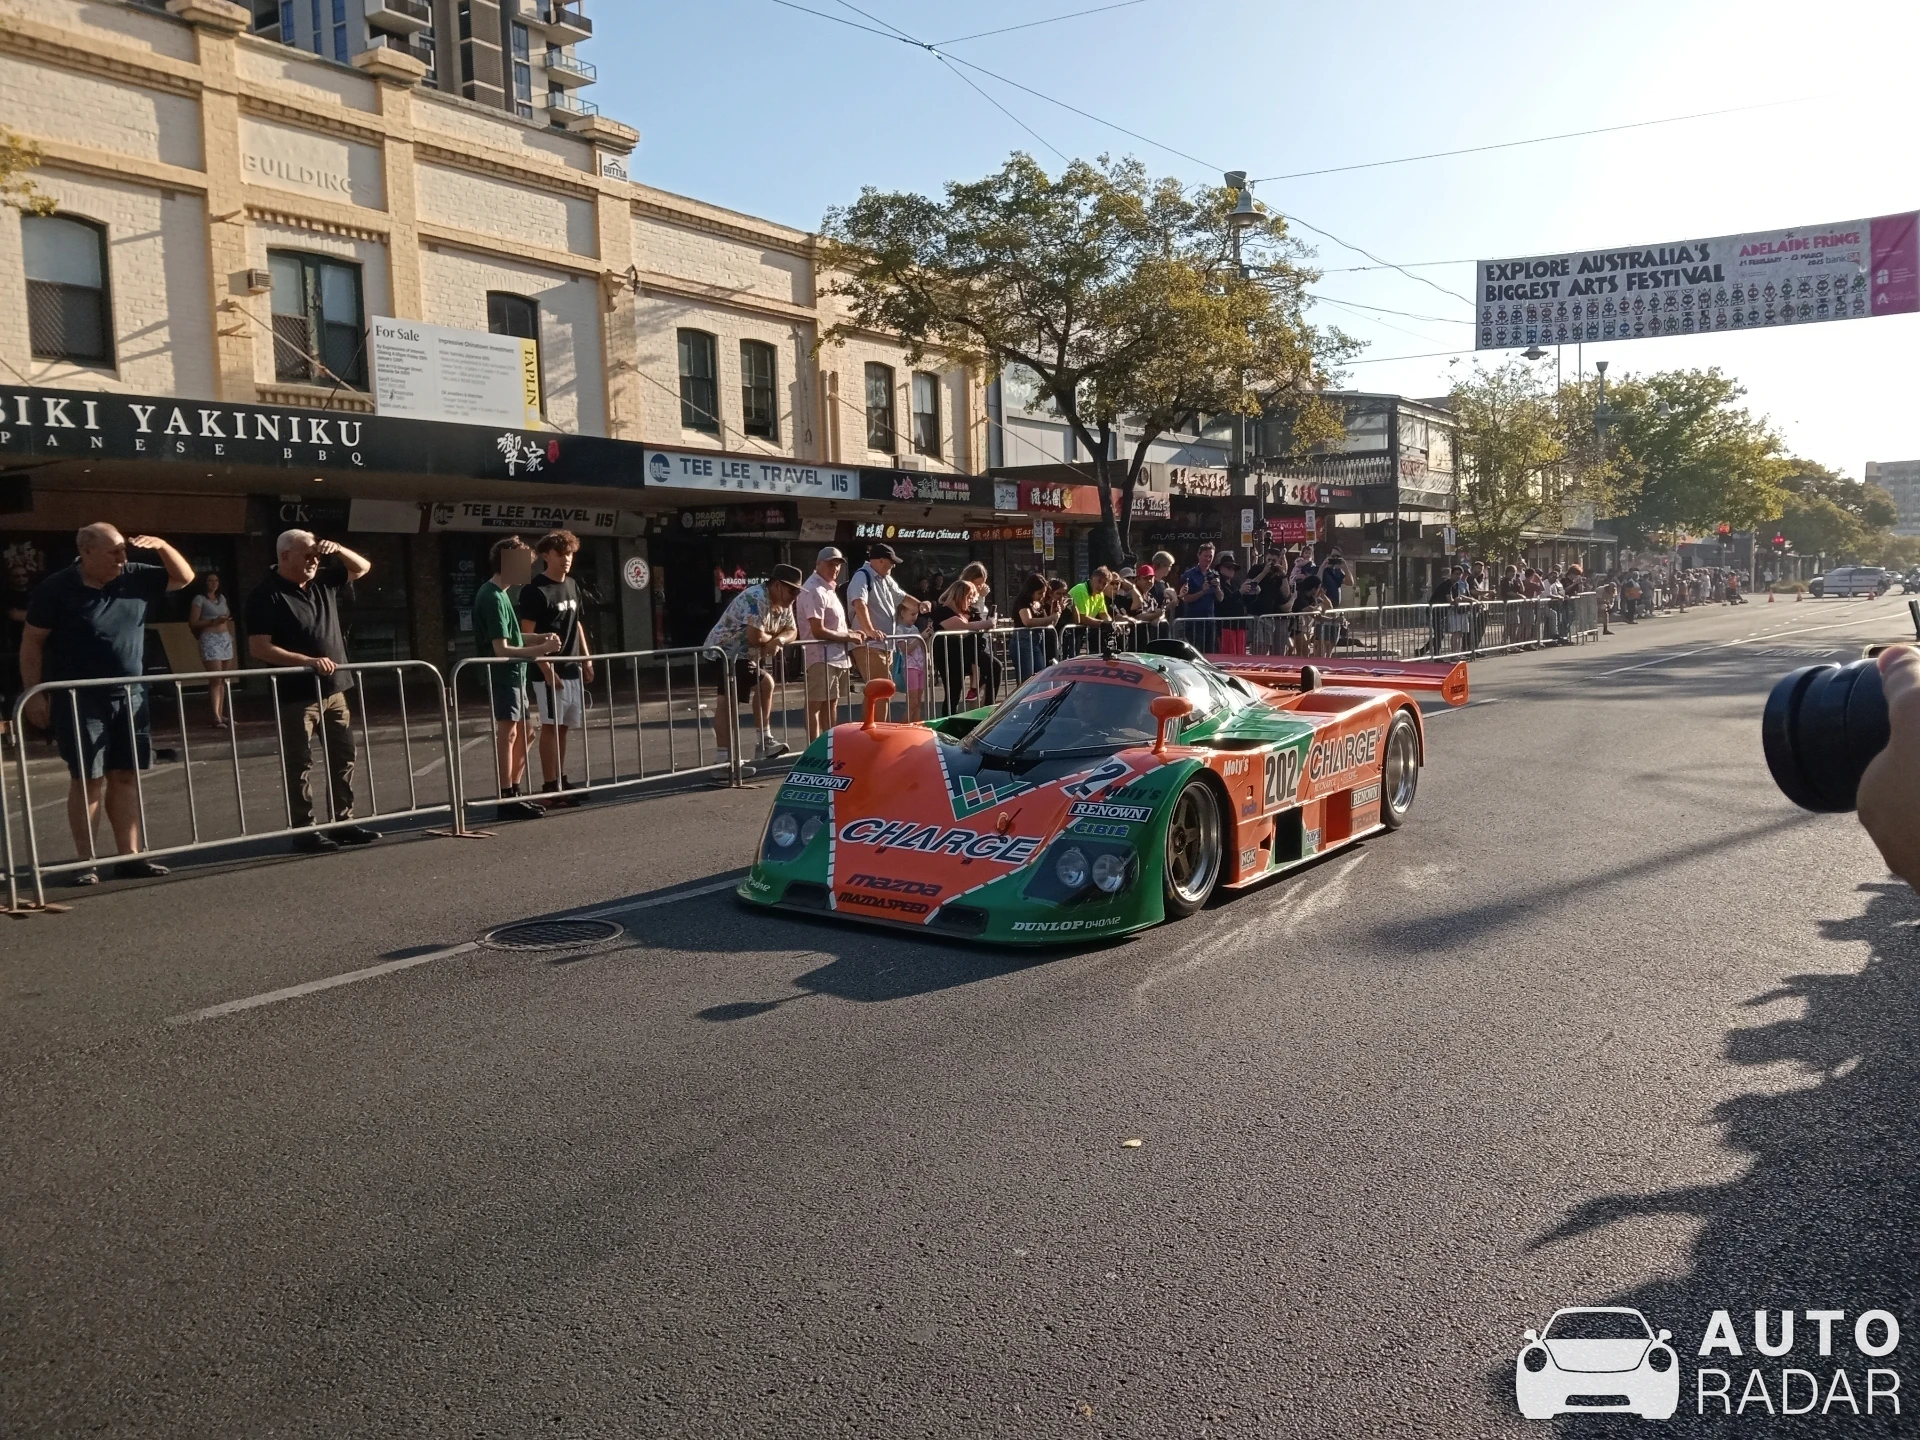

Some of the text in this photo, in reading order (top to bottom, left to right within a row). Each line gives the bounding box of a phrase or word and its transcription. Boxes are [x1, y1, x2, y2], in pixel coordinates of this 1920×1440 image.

[1739, 230, 1860, 257] ADELAIDE FRINGE
[1485, 242, 1711, 282] EXPLORE AUSTRALIA'S
[1485, 263, 1725, 302] BIGGEST ARTS FESTIVAL
[375, 325, 420, 342] For Sale
[524, 347, 537, 406] TAPLIN
[0, 395, 363, 448] IKI YAKINIKU
[283, 447, 364, 467] BBQ
[679, 457, 849, 492] TEE LEE TRAVEL 115
[280, 504, 310, 522] CK
[462, 503, 615, 528] TEE LEE TRAVEL 115
[695, 511, 726, 520] DRAGON
[711, 518, 726, 527] POT
[897, 528, 916, 538] East
[916, 528, 936, 539] Taste
[935, 529, 962, 540] Chinese
[1150, 531, 1222, 541] ATLAS POOL CLUB
[1049, 665, 1144, 685] mazda
[1309, 726, 1378, 783] CHARGE
[1223, 756, 1249, 778] Moly's
[1265, 749, 1297, 806] 202
[787, 773, 847, 788] RENOWN
[1352, 786, 1378, 806] RENOWN
[1073, 803, 1146, 819] RENOWN
[838, 817, 1047, 865] CHARGE
[1241, 849, 1256, 867] NGK
[845, 873, 944, 898] mazda
[838, 891, 930, 915] MAZDASPEED
[1011, 920, 1085, 931] DUNLOP
